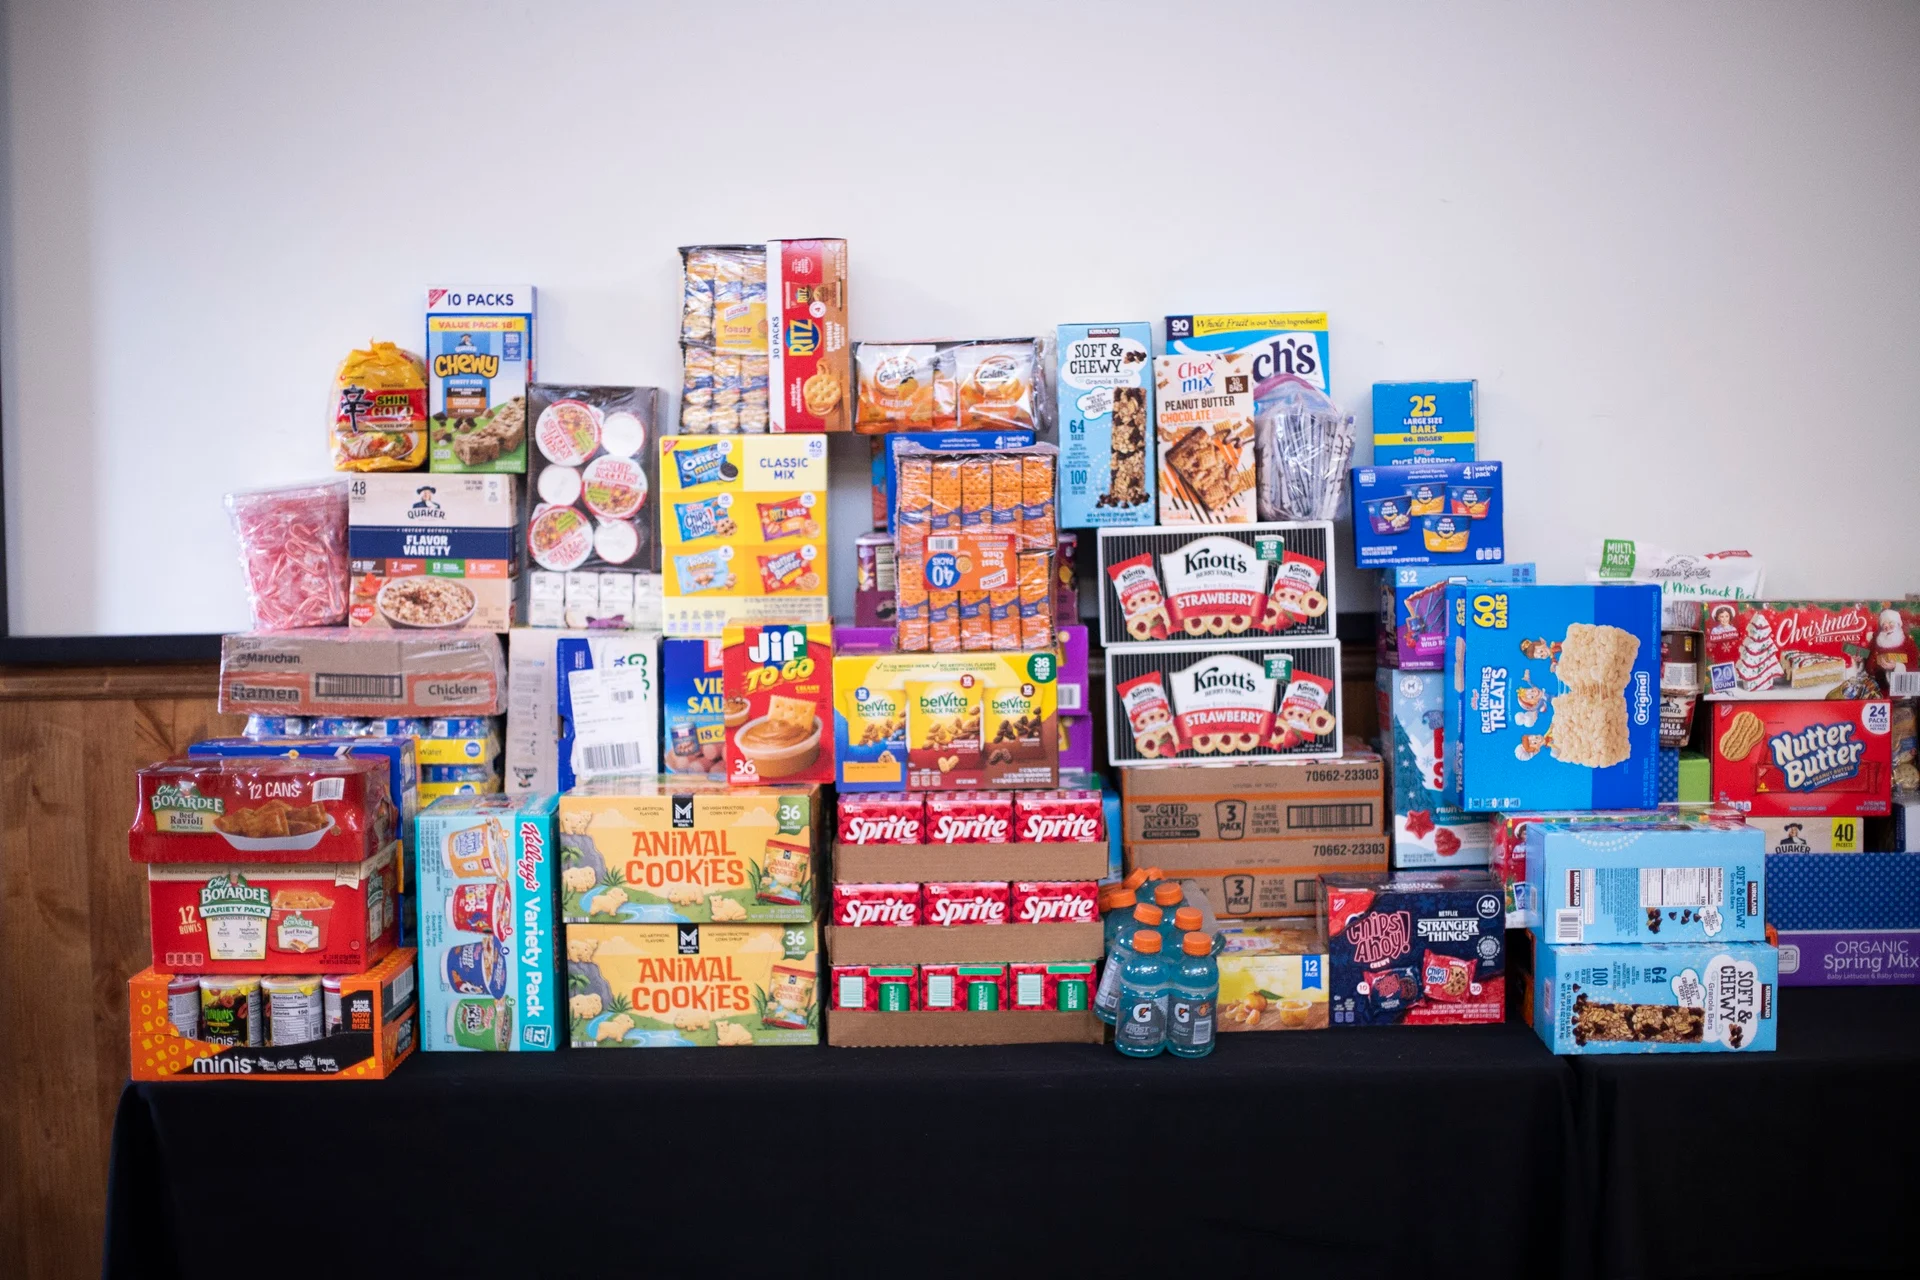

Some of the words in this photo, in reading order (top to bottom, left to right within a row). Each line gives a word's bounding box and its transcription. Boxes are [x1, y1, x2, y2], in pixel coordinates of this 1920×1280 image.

[448, 294, 461, 306] 10
[468, 294, 514, 306] PACKS
[725, 305, 748, 317] Lance
[439, 321, 469, 329] VALUE
[472, 321, 497, 329] PACK
[723, 325, 752, 335] Toasty
[1172, 320, 1189, 331] 90
[1197, 319, 1225, 328] Whole
[1226, 317, 1249, 327] Fruit
[789, 319, 813, 356] RITZ
[773, 346, 780, 359] 30
[1075, 344, 1106, 358] SOFT
[1111, 343, 1123, 357] &
[1070, 359, 1122, 374] CHEWY
[1253, 339, 1316, 383] ch's
[1178, 359, 1217, 379] Chex
[1182, 373, 1215, 393] mix
[376, 396, 408, 405] SHIN
[1165, 397, 1199, 411] PEANUT
[1202, 396, 1235, 408] BUTTER
[1410, 395, 1436, 417] 25
[1160, 409, 1211, 423] CHOCOLATE
[1070, 420, 1085, 433] 64
[1411, 425, 1436, 433] BARS
[995, 436, 1003, 446] 4
[1007, 435, 1029, 443] variety
[682, 451, 721, 471] OREO
[760, 458, 808, 468] CLASSIC
[774, 470, 794, 480] MIX
[1071, 470, 1087, 484] 100
[1463, 466, 1471, 476] 4
[352, 481, 366, 495] 48
[407, 508, 445, 519] QUAKER
[406, 535, 448, 545] FLAVOR
[1261, 541, 1276, 550] 36
[403, 546, 451, 556] VARIETY
[1607, 543, 1631, 553] MULTI
[1184, 548, 1248, 575] Knott's
[1607, 554, 1630, 565] PACK
[932, 566, 954, 586] 40
[982, 571, 1007, 587] Lance
[1196, 570, 1215, 578] BERRY
[1400, 570, 1417, 583] 32
[1673, 583, 1695, 594] Mix
[1700, 584, 1731, 597] Snack
[1177, 591, 1255, 609] STRAWBERRY
[1473, 595, 1495, 628] 60
[1494, 594, 1508, 629] BARS
[1776, 610, 1867, 646] Christmas
[1814, 635, 1832, 643] TREE
[1834, 634, 1860, 642] CAKES
[748, 631, 804, 663] Jif
[246, 653, 300, 664] Maruchan
[1035, 658, 1050, 667] 36
[1270, 660, 1286, 669] 36
[745, 666, 778, 691] TO
[782, 658, 815, 680] GO
[1193, 667, 1256, 693] Knott's
[1713, 667, 1732, 682] 20
[231, 683, 299, 700] Ramen
[428, 684, 477, 695] Chicken
[1480, 666, 1492, 709] KRISPIES
[920, 696, 968, 708] belVita
[992, 700, 1030, 709] belVita
[1491, 668, 1507, 730] TREATS
[1636, 674, 1650, 722] Original
[857, 702, 896, 712] belVita
[1870, 705, 1887, 718] 24
[1185, 710, 1264, 727] STRAWBERRY
[1482, 710, 1491, 734] RICE
[1771, 724, 1853, 766] Nutter
[734, 760, 755, 775] 36
[1784, 742, 1863, 788] Butter
[1306, 769, 1379, 782] 70662-23303
[1813, 772, 1833, 782] PEANUT
[1834, 765, 1854, 775] BUTTER
[1832, 772, 1848, 780] Cookie
[157, 786, 178, 795] Chef
[250, 785, 262, 799] 12
[265, 782, 301, 798] CANS
[152, 795, 223, 812] BOYARDEE
[1156, 803, 1188, 817] CUP
[780, 805, 800, 820] 36
[1226, 805, 1236, 821] 3
[170, 816, 203, 825] Ravioli
[1023, 813, 1097, 842] Sprite
[1144, 814, 1199, 829] NOODLES
[1220, 822, 1242, 831] PACK
[846, 815, 919, 844] Sprite
[934, 814, 1008, 843] Sprite
[1834, 824, 1854, 842] 40
[518, 822, 544, 892] Kellogg's
[1313, 844, 1385, 856] 70662-23303
[1775, 845, 1811, 854] QUAKER
[1736, 866, 1745, 883] SOFT
[208, 877, 228, 889] Chef
[1234, 880, 1244, 896] 3
[201, 887, 269, 904] BOYARDEE
[1228, 896, 1249, 906] PACK
[205, 906, 242, 914] VARIETY
[842, 897, 916, 927] Sprite
[931, 896, 1005, 926] Sprite
[1020, 894, 1094, 924] Sprite
[1481, 900, 1495, 909] 40
[178, 905, 195, 925] 12
[1736, 896, 1745, 929] CHEWY
[179, 924, 202, 935] BOWLS
[522, 896, 544, 968] Variety
[1417, 919, 1479, 935] STRANGER
[785, 931, 806, 946] 36
[1428, 932, 1470, 942] THINGS
[1835, 941, 1909, 954] ORGANIC
[1304, 960, 1318, 972] 12
[1370, 958, 1390, 969] CHEWY
[1824, 954, 1883, 972] Spring
[1887, 954, 1919, 969] Mix
[1426, 967, 1445, 976] Chips
[1592, 968, 1608, 986] 100
[1652, 967, 1667, 984] 64
[525, 971, 544, 1017] Pack
[1720, 965, 1736, 1022] CHEWY
[1738, 971, 1753, 1006] SOFT
[1738, 1010, 1752, 1024] &
[532, 1027, 545, 1043] 12
[194, 1056, 252, 1074] minis
